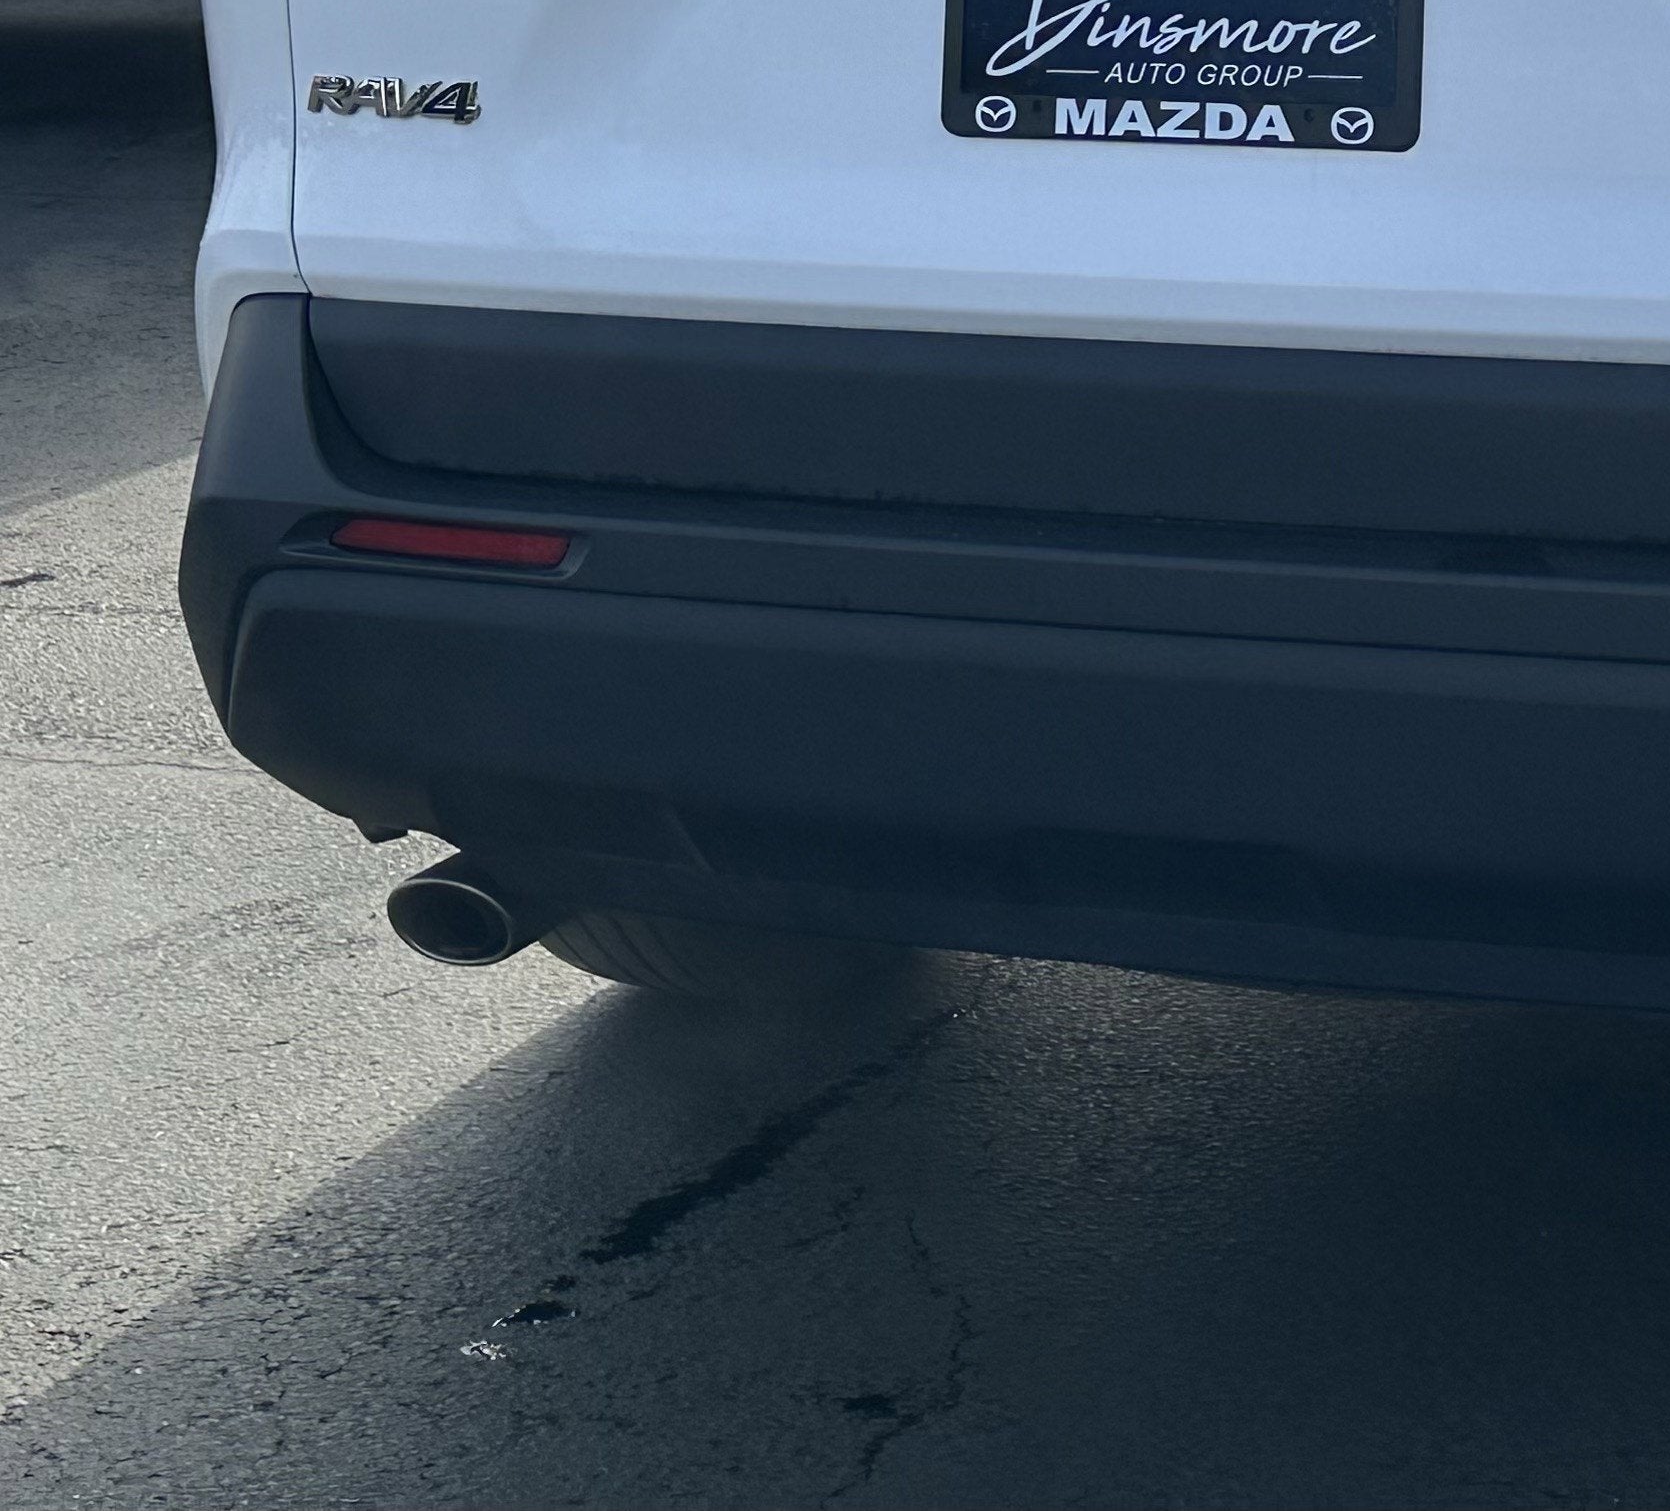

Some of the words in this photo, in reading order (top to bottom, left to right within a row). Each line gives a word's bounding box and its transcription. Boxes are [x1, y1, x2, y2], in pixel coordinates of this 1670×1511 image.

[1104, 62, 1186, 85] AUTO
[1196, 63, 1303, 88] GROUP
[307, 74, 482, 125] RAV4
[1054, 97, 1296, 143] MAZDA
